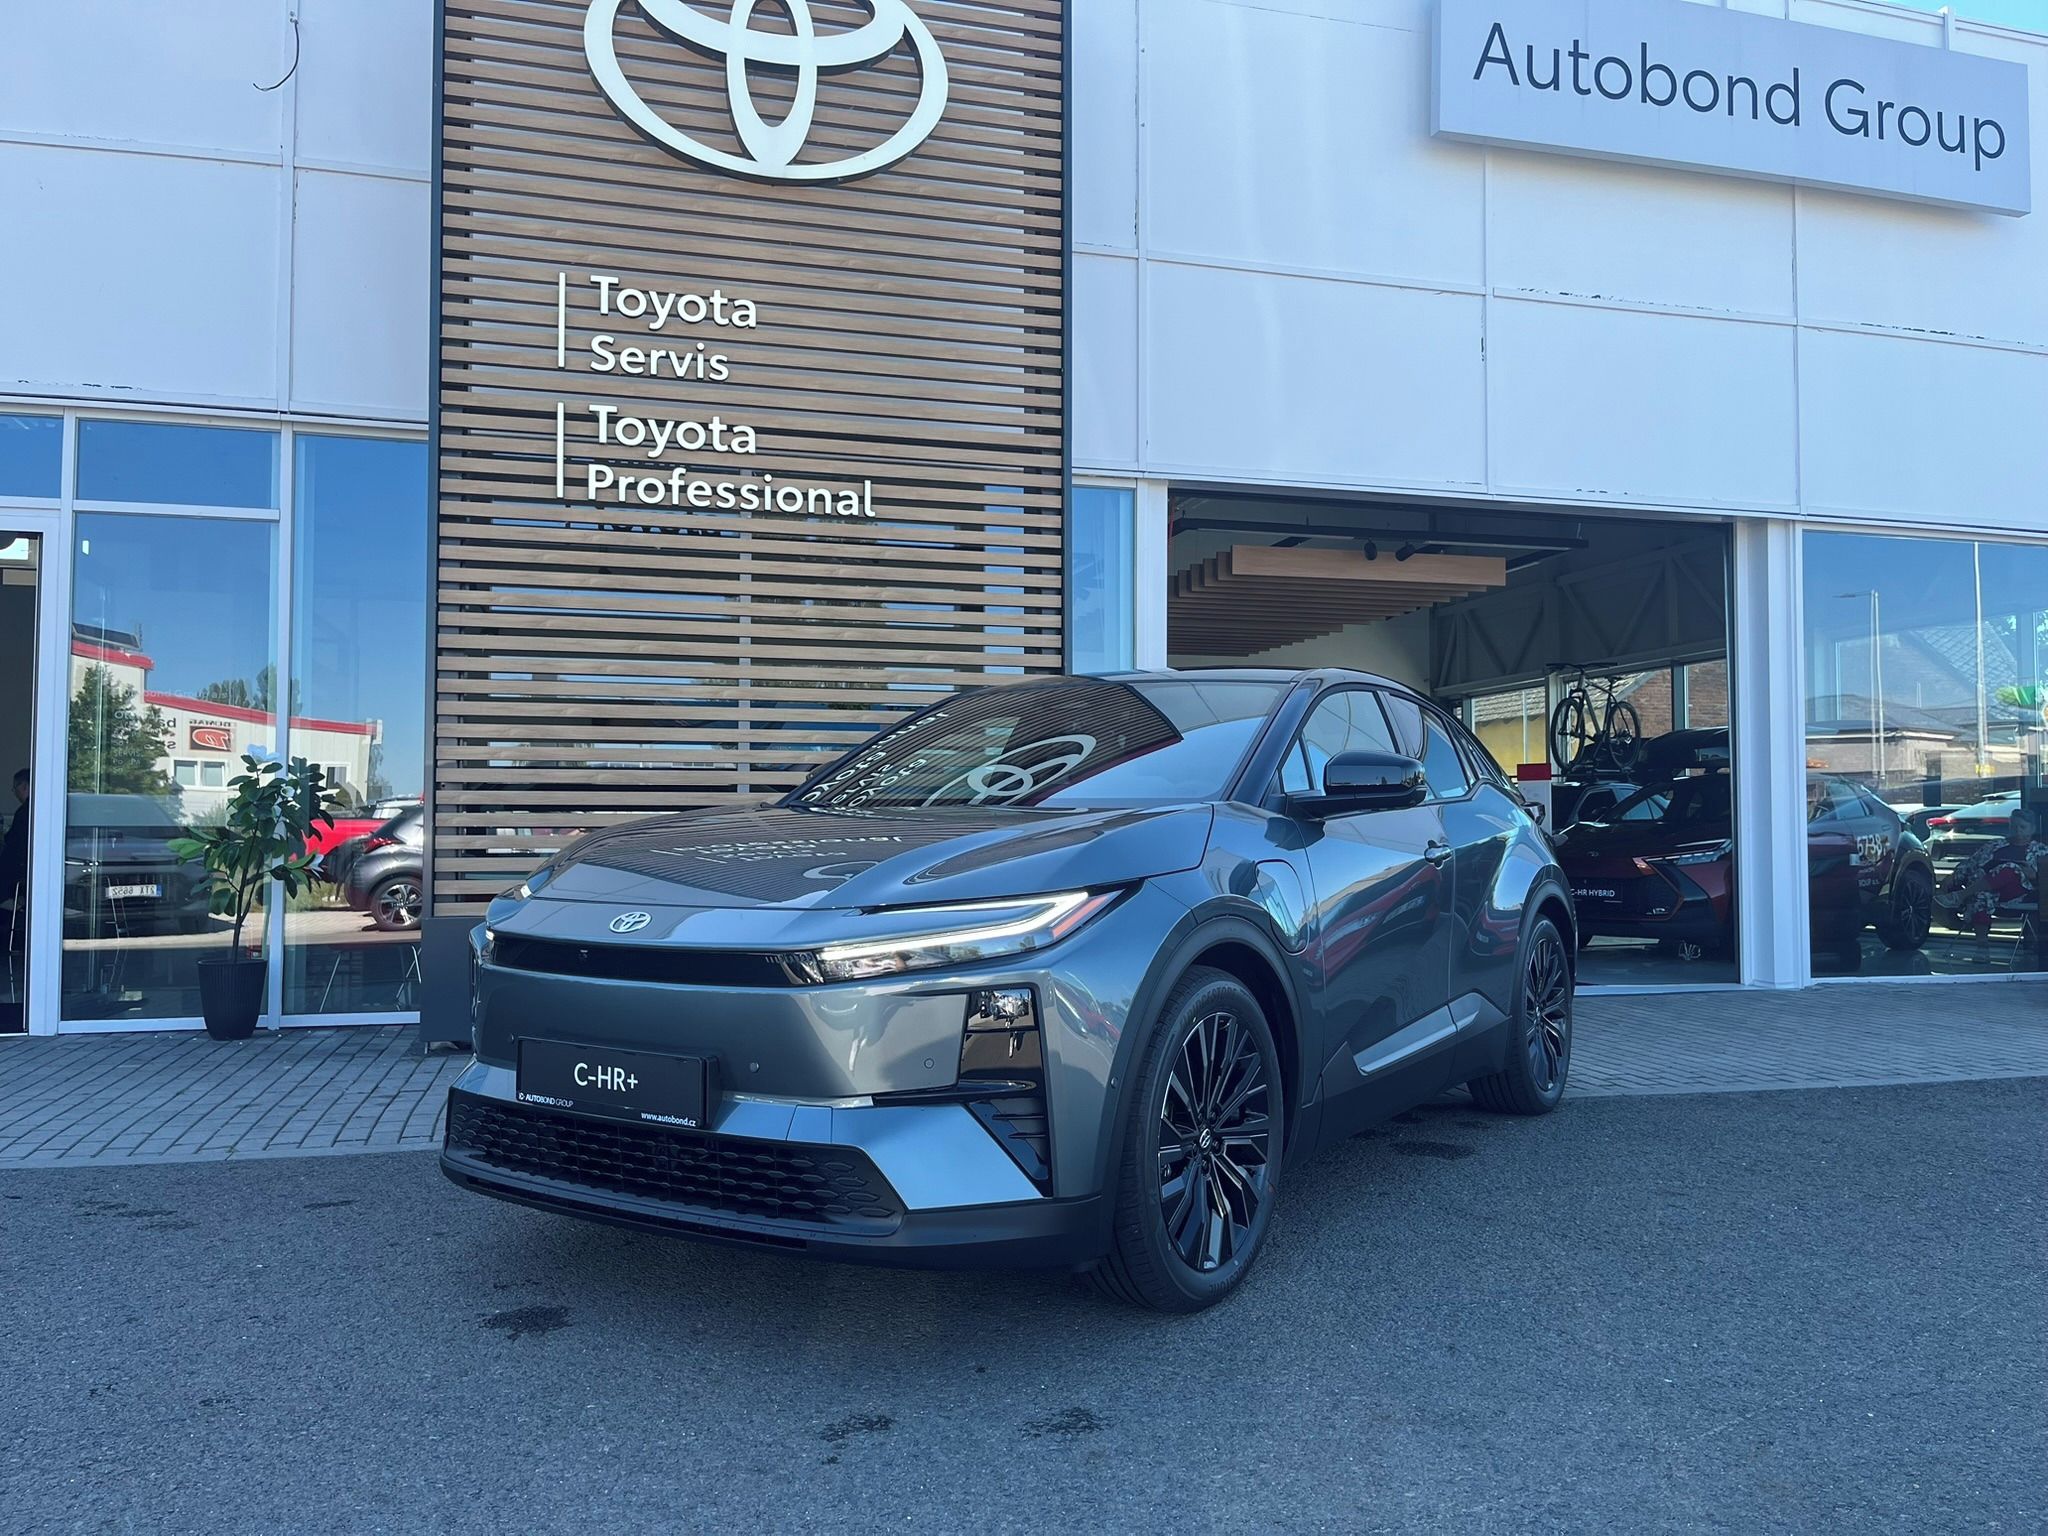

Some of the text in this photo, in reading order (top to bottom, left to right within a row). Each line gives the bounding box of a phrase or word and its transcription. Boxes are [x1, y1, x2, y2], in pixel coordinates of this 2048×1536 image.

[1473, 22, 2006, 171] Autobond Group
[590, 275, 757, 330] Toyota
[590, 335, 729, 381] Servis
[589, 404, 756, 457] Toyota
[587, 464, 876, 517] Professional
[1588, 889, 1616, 898] HYBRID
[574, 1062, 638, 1091] C-HR+
[525, 1093, 574, 1108] AUTOBOND GROUP
[640, 1111, 696, 1127] www.autobond.cz
